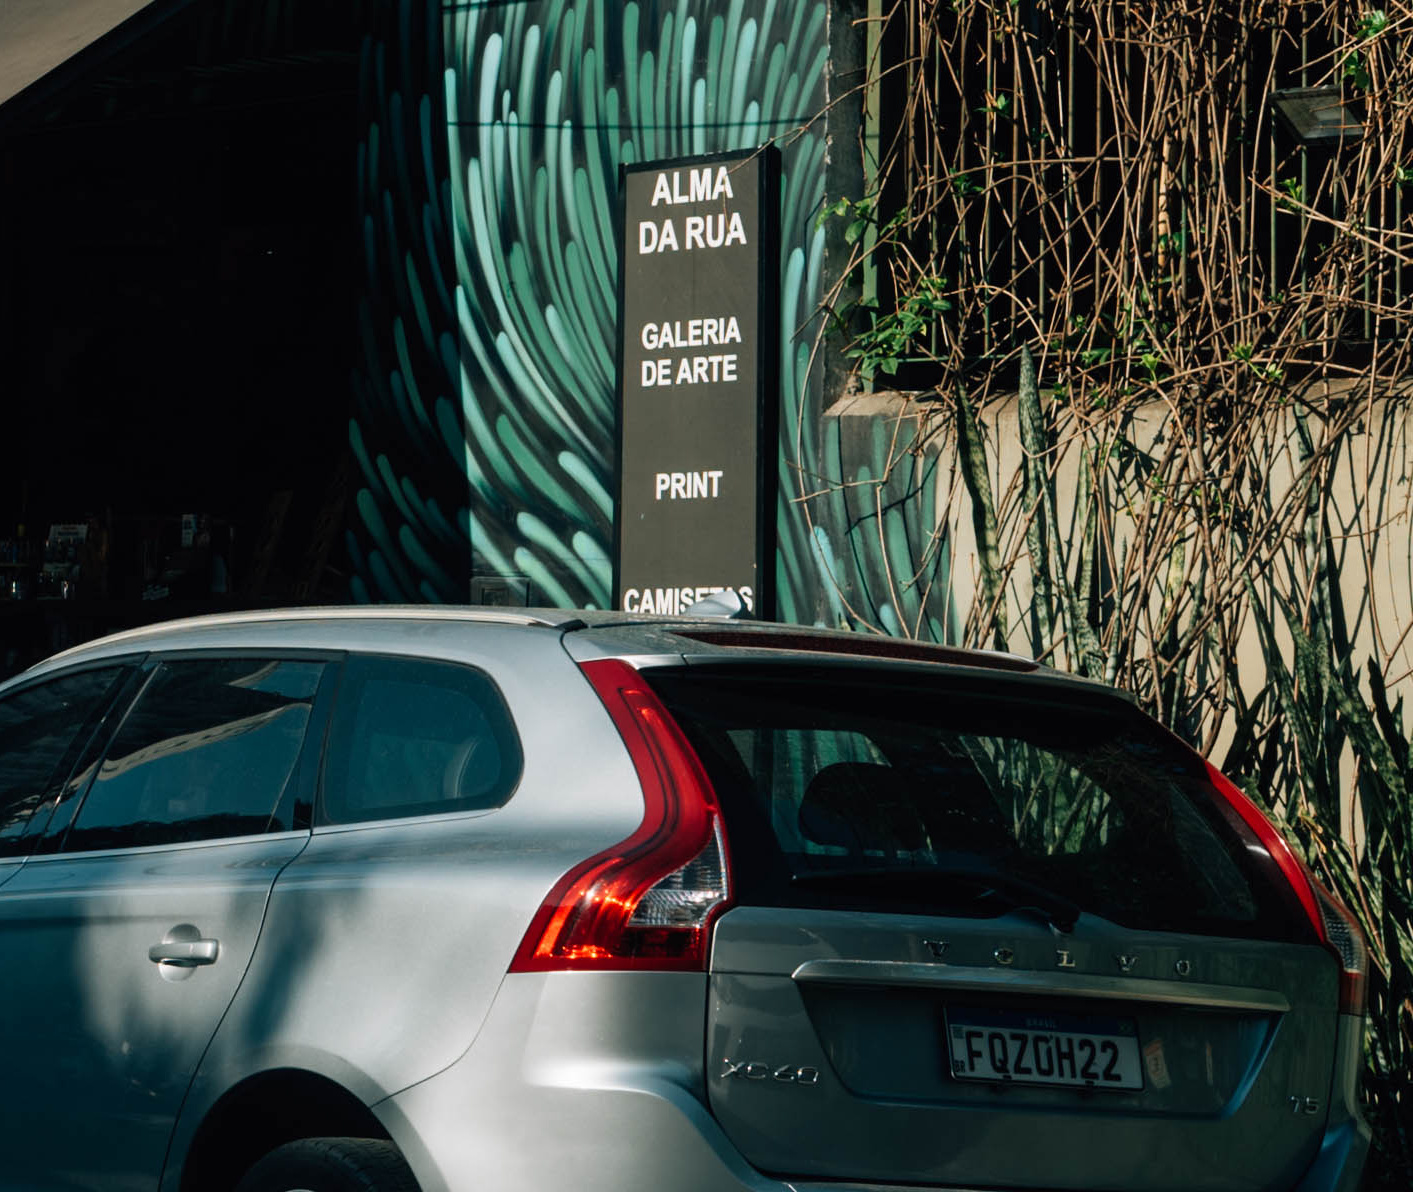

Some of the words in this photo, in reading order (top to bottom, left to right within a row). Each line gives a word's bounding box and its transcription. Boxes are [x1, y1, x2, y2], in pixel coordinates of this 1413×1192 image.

[650, 166, 734, 208] ALMA
[638, 219, 678, 255] DA
[685, 211, 748, 249] RUA
[641, 316, 742, 351] GALERIA
[641, 357, 672, 388] DE
[675, 354, 738, 385] ARTE
[655, 470, 723, 500] PRINT
[623, 585, 754, 616] CAMISES
[922, 938, 1194, 978] VOLVO
[720, 1057, 820, 1087] XC60
